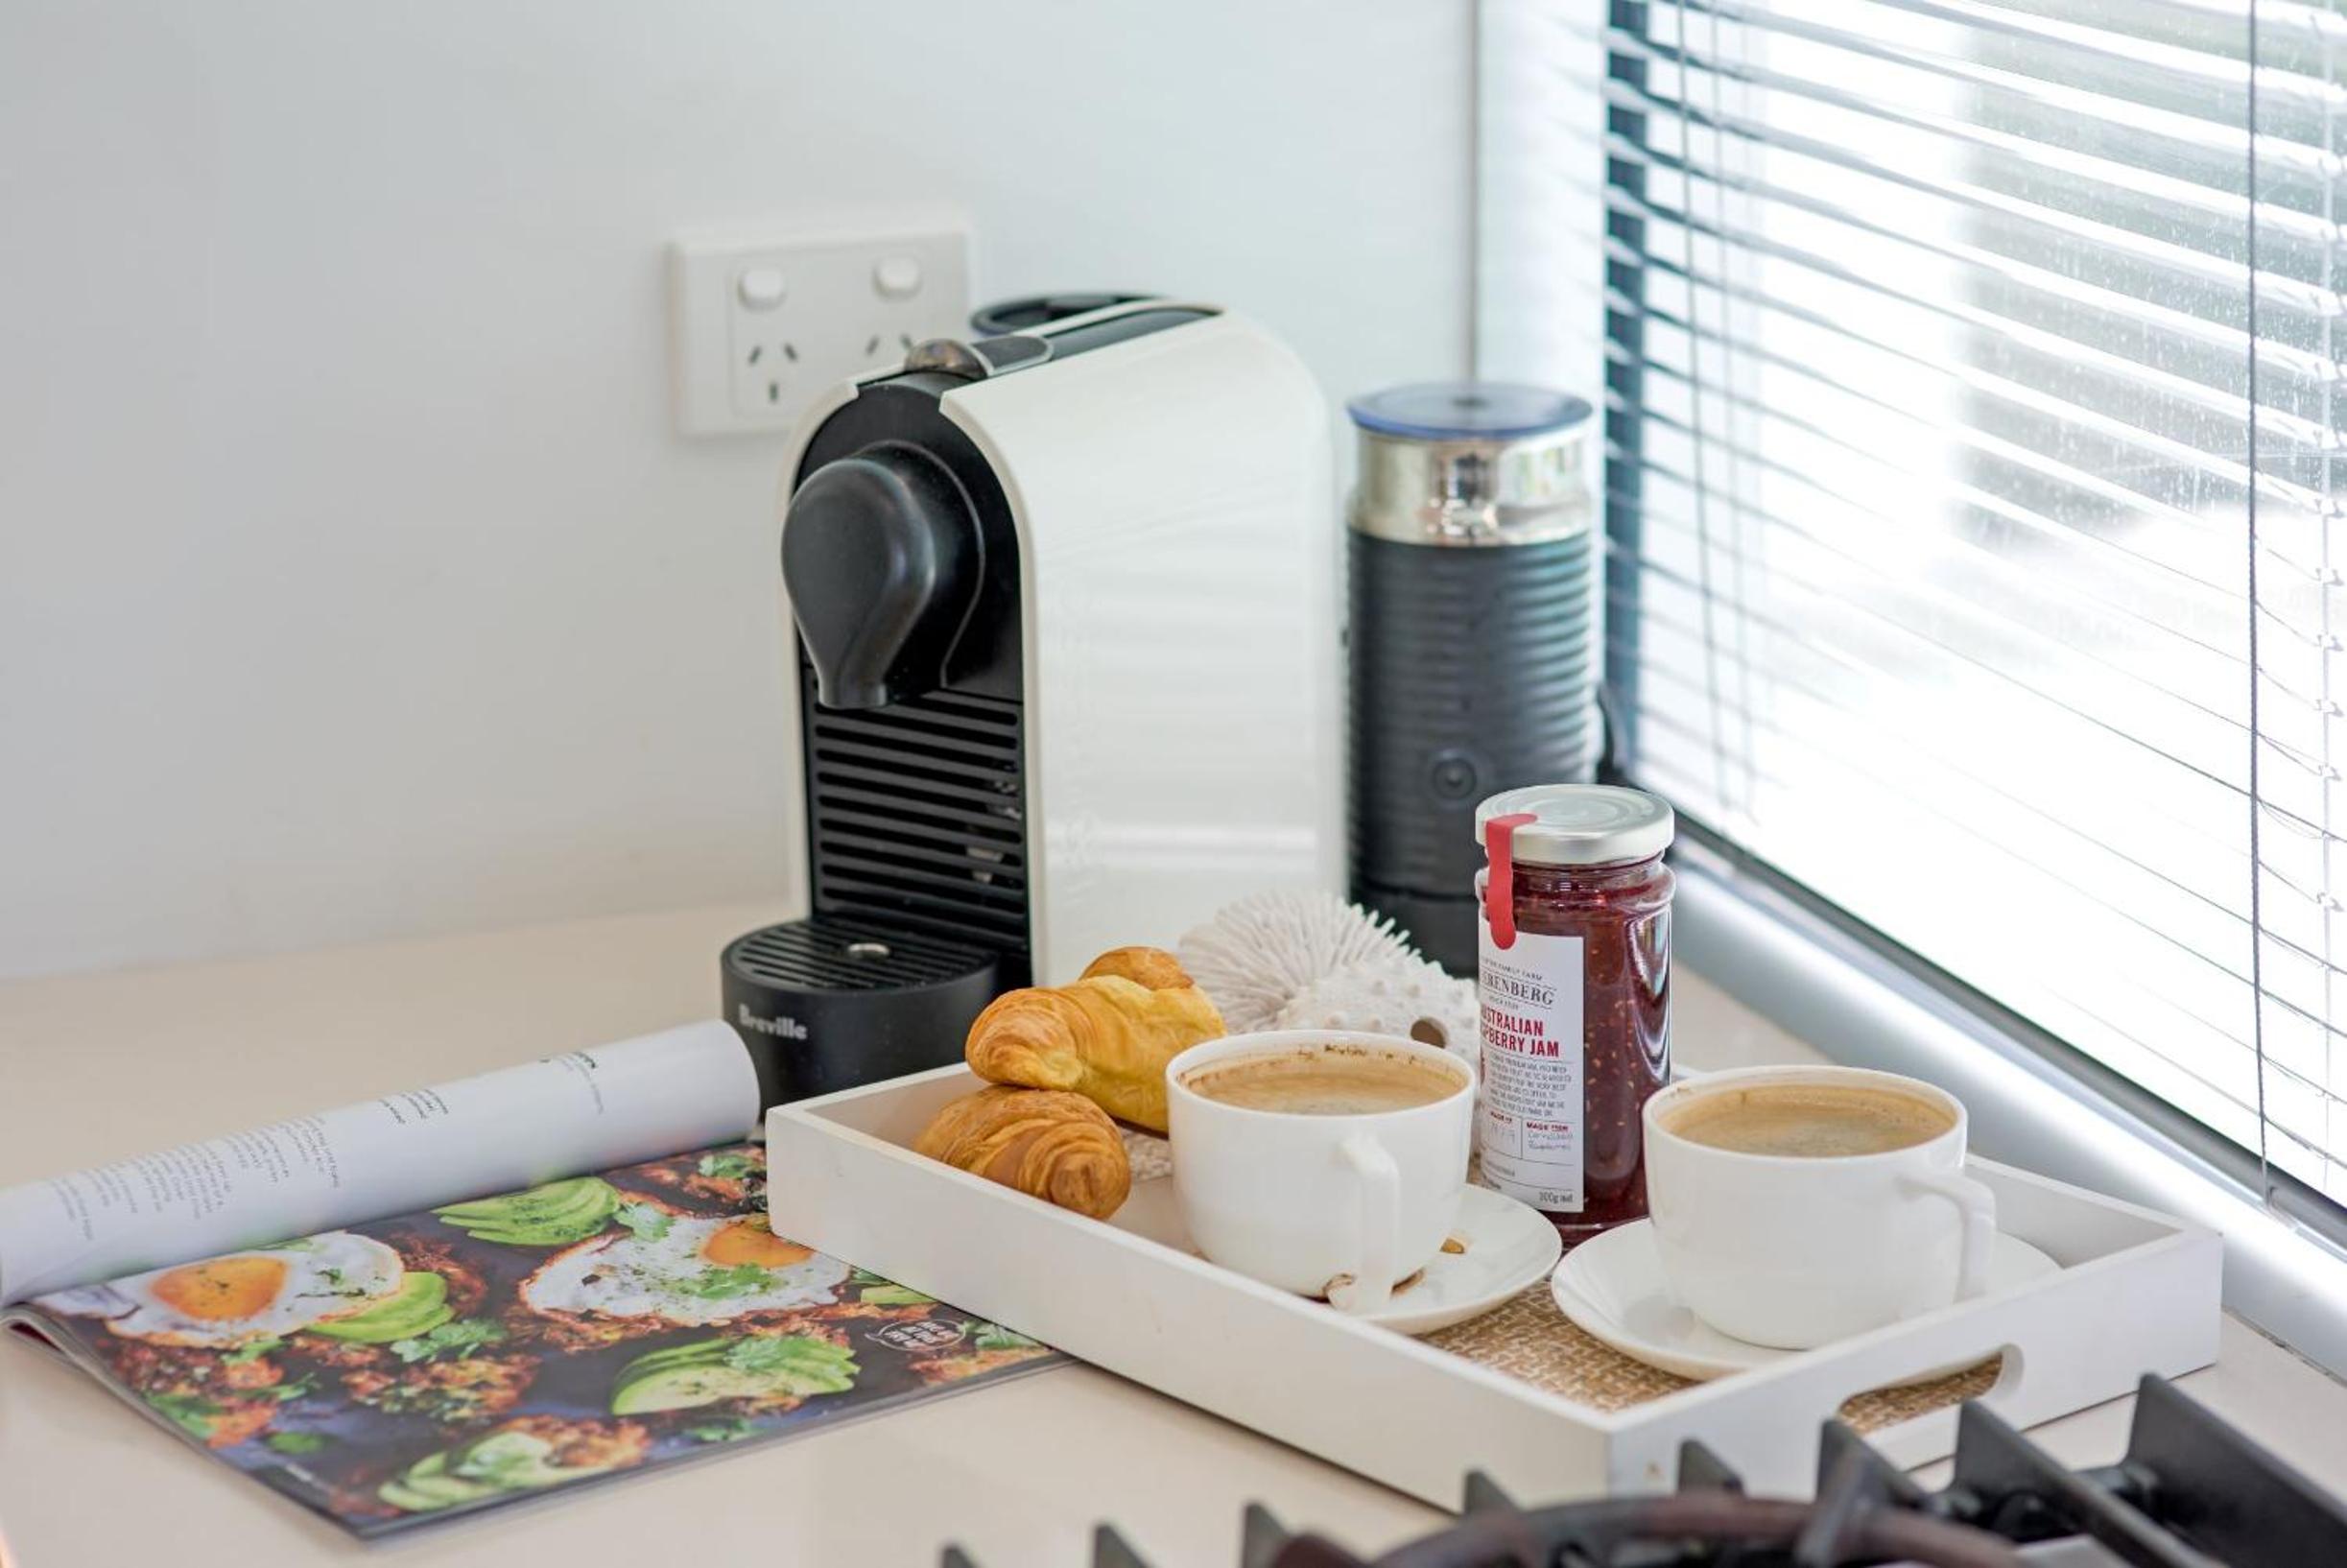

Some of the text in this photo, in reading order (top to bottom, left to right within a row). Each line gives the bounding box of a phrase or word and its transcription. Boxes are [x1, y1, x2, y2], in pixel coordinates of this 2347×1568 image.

[738, 1004, 808, 1040] Breville
[1482, 1005, 1544, 1036] USTRALIAN
[1529, 1039, 1559, 1057] JAM
